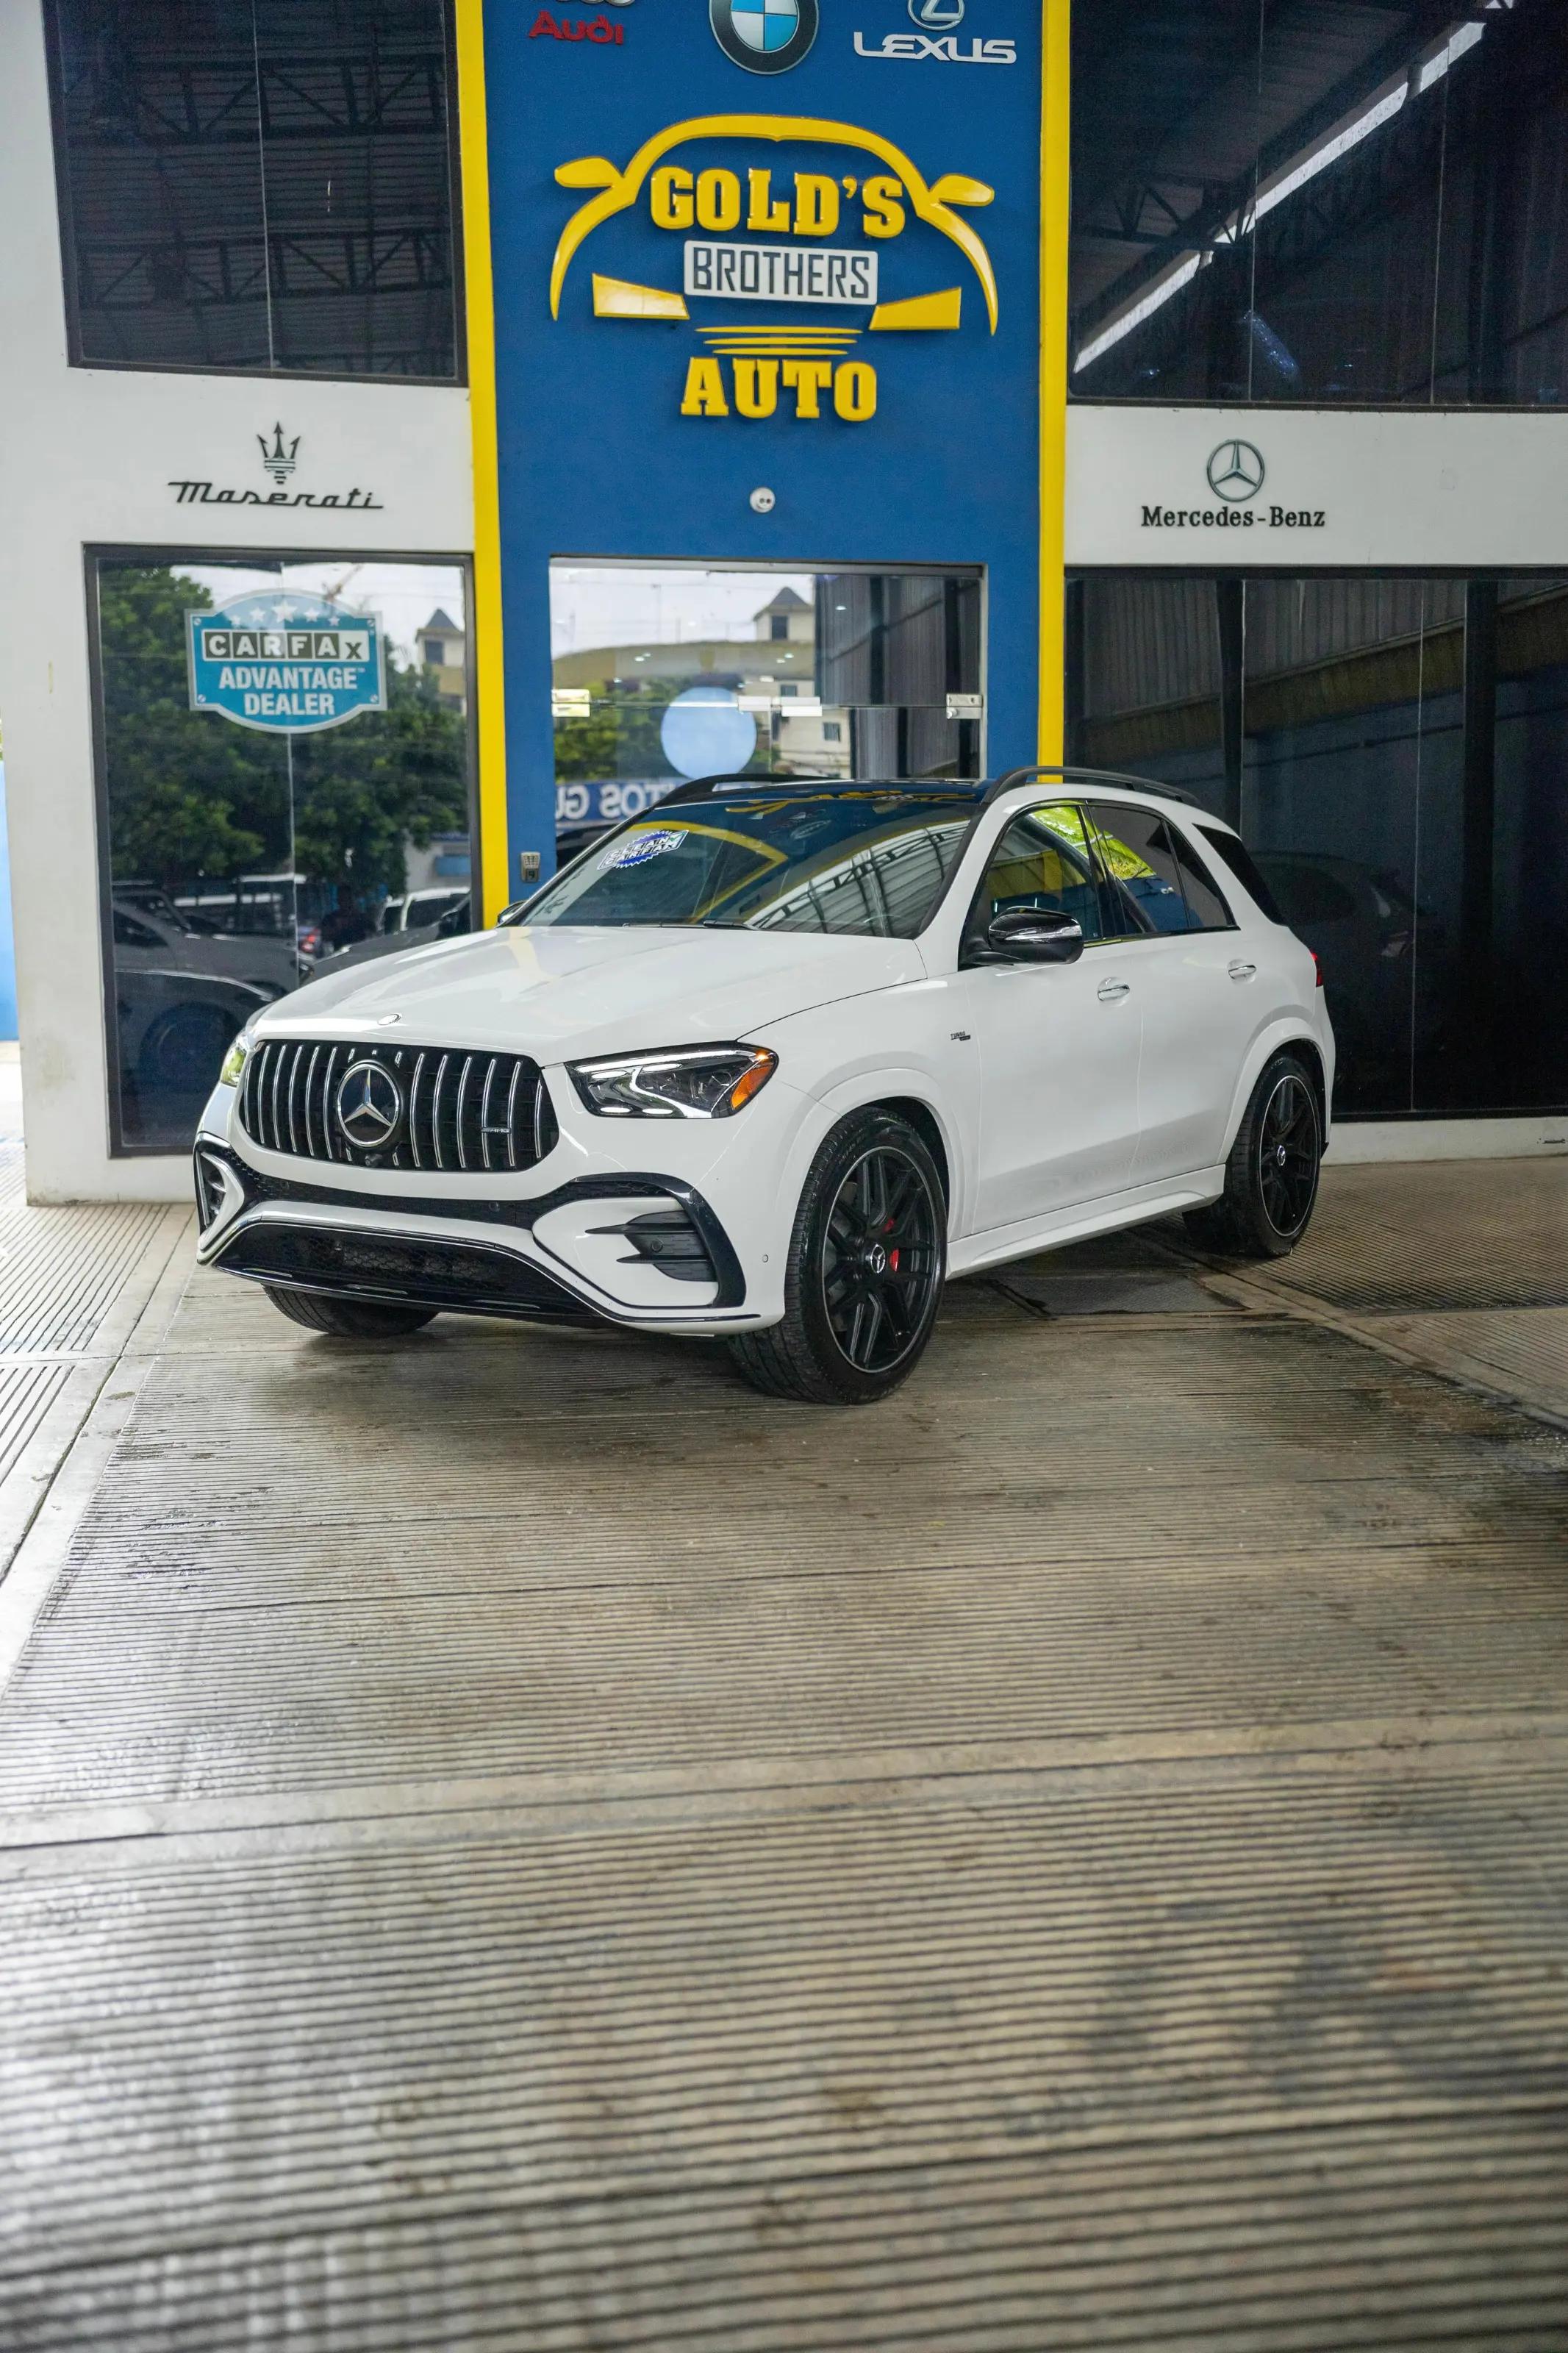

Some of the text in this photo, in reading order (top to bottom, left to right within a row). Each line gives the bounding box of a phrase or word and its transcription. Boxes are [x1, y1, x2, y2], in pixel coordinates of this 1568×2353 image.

[529, 10, 624, 45] Audi
[853, 32, 1017, 64] LEXUS
[651, 165, 906, 239] GOLD'S
[692, 246, 870, 299] BROTHERS
[681, 357, 877, 421] AUTO
[168, 481, 384, 509] Maserati
[1141, 505, 1325, 528] Mercedes-Benz
[208, 634, 362, 660] CARFAX
[244, 693, 335, 716] DEALER
